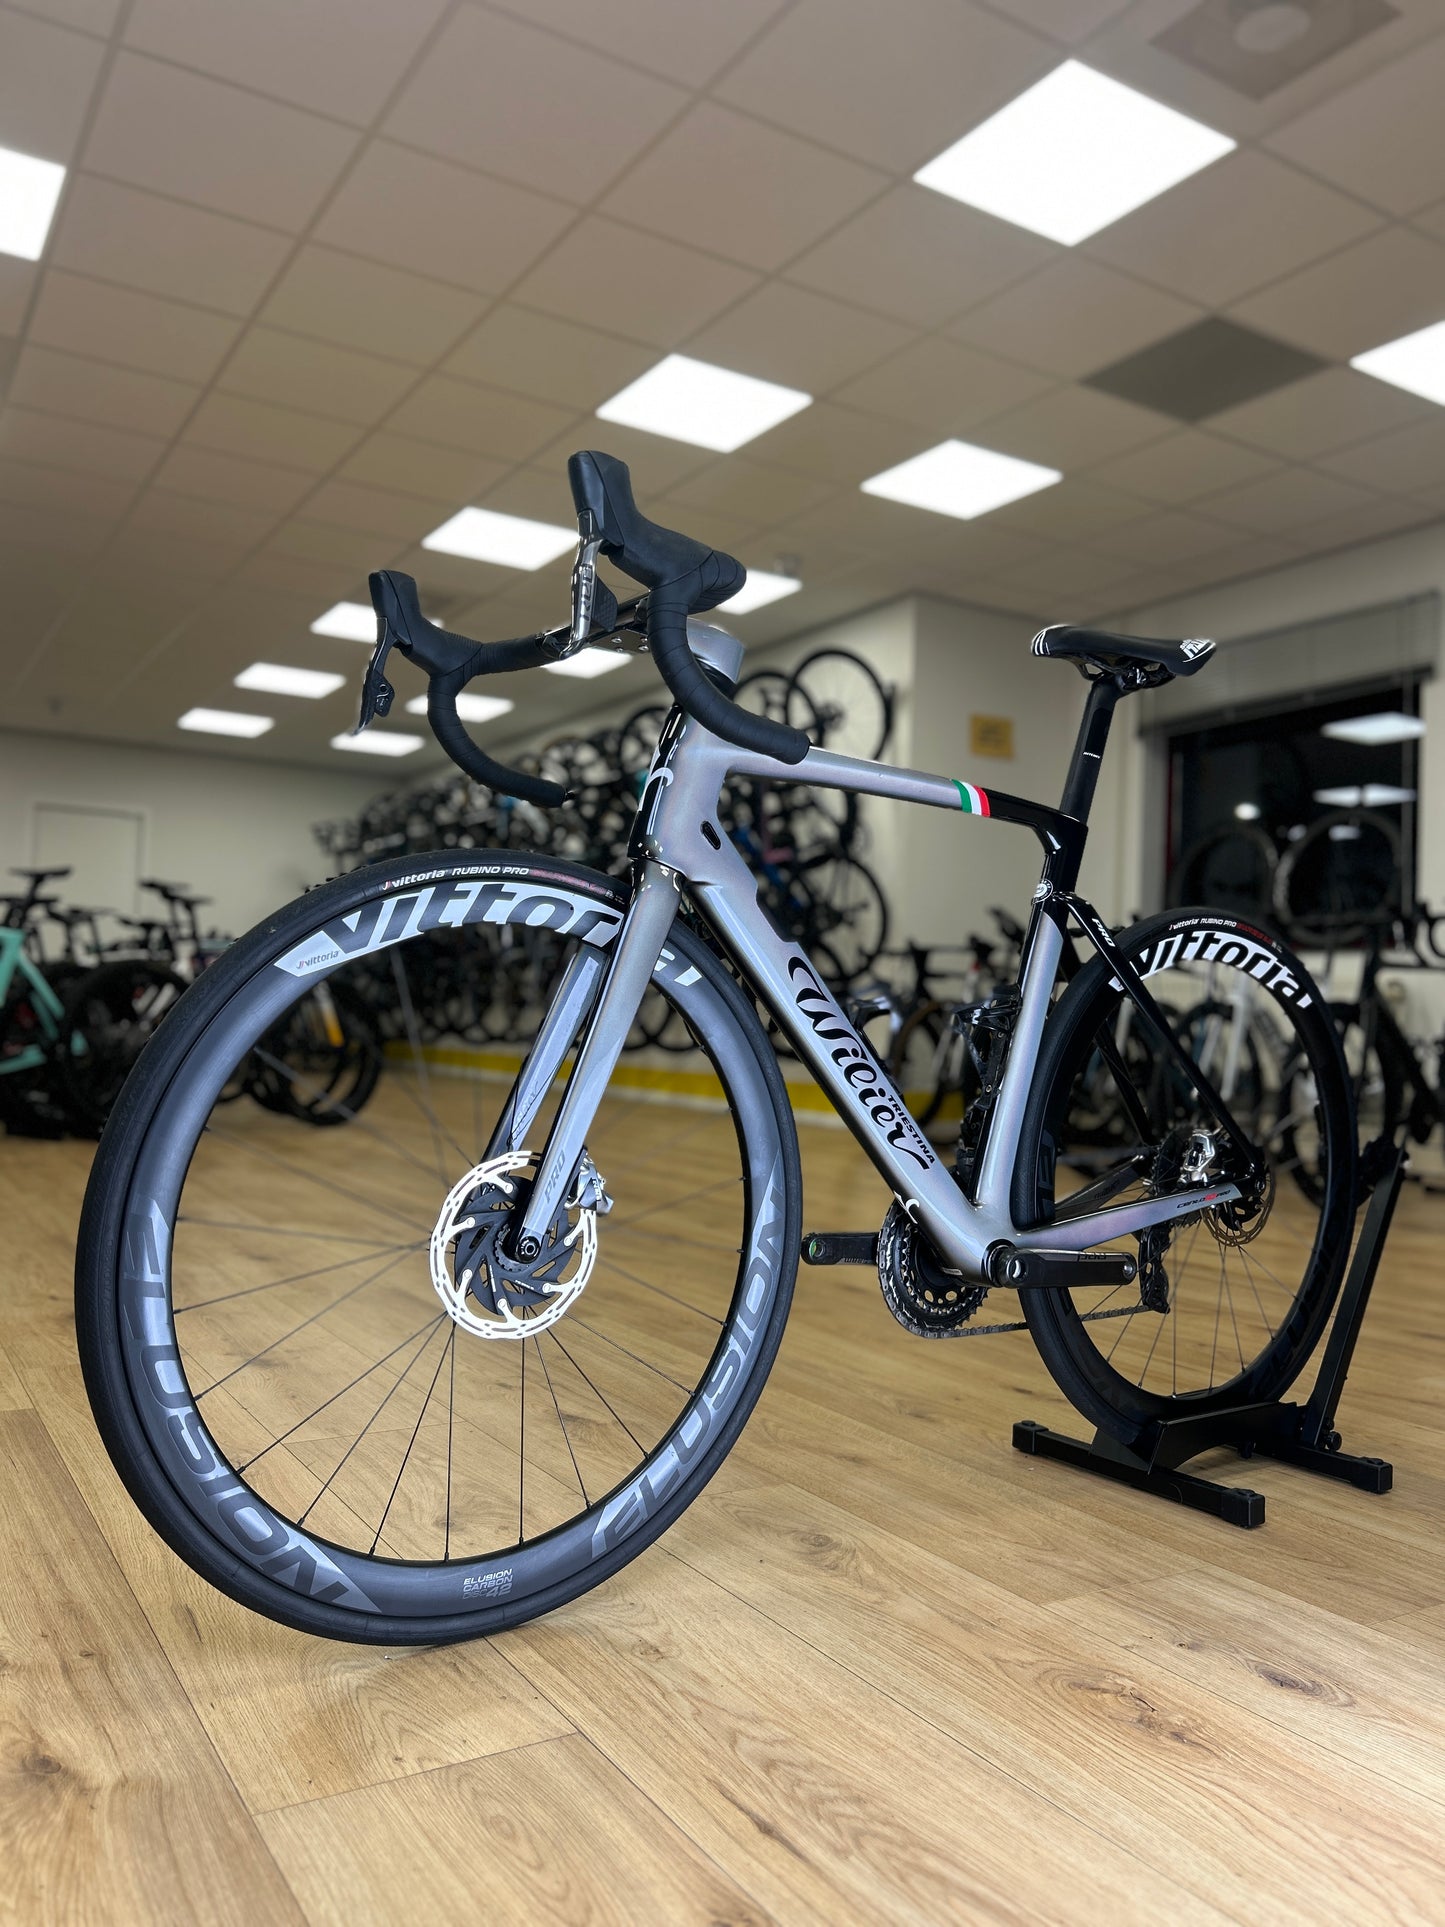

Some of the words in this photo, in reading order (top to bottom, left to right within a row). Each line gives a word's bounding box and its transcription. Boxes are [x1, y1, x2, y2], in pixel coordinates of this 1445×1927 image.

[391, 869, 447, 888] vittoria
[451, 866, 501, 876] RUBINO
[502, 867, 530, 876] PRO
[1091, 918, 1115, 947] PRO
[1222, 920, 1237, 928] PRO
[304, 951, 339, 967] vittoria
[887, 1094, 936, 1164] TRIESTINA
[544, 1149, 566, 1204] PRO
[602, 1188, 785, 1553] ELUSION
[122, 1212, 348, 1600] ELUSION
[463, 1568, 513, 1585] ELUSION
[463, 1575, 513, 1592] CARBON
[486, 1583, 512, 1598] 42
